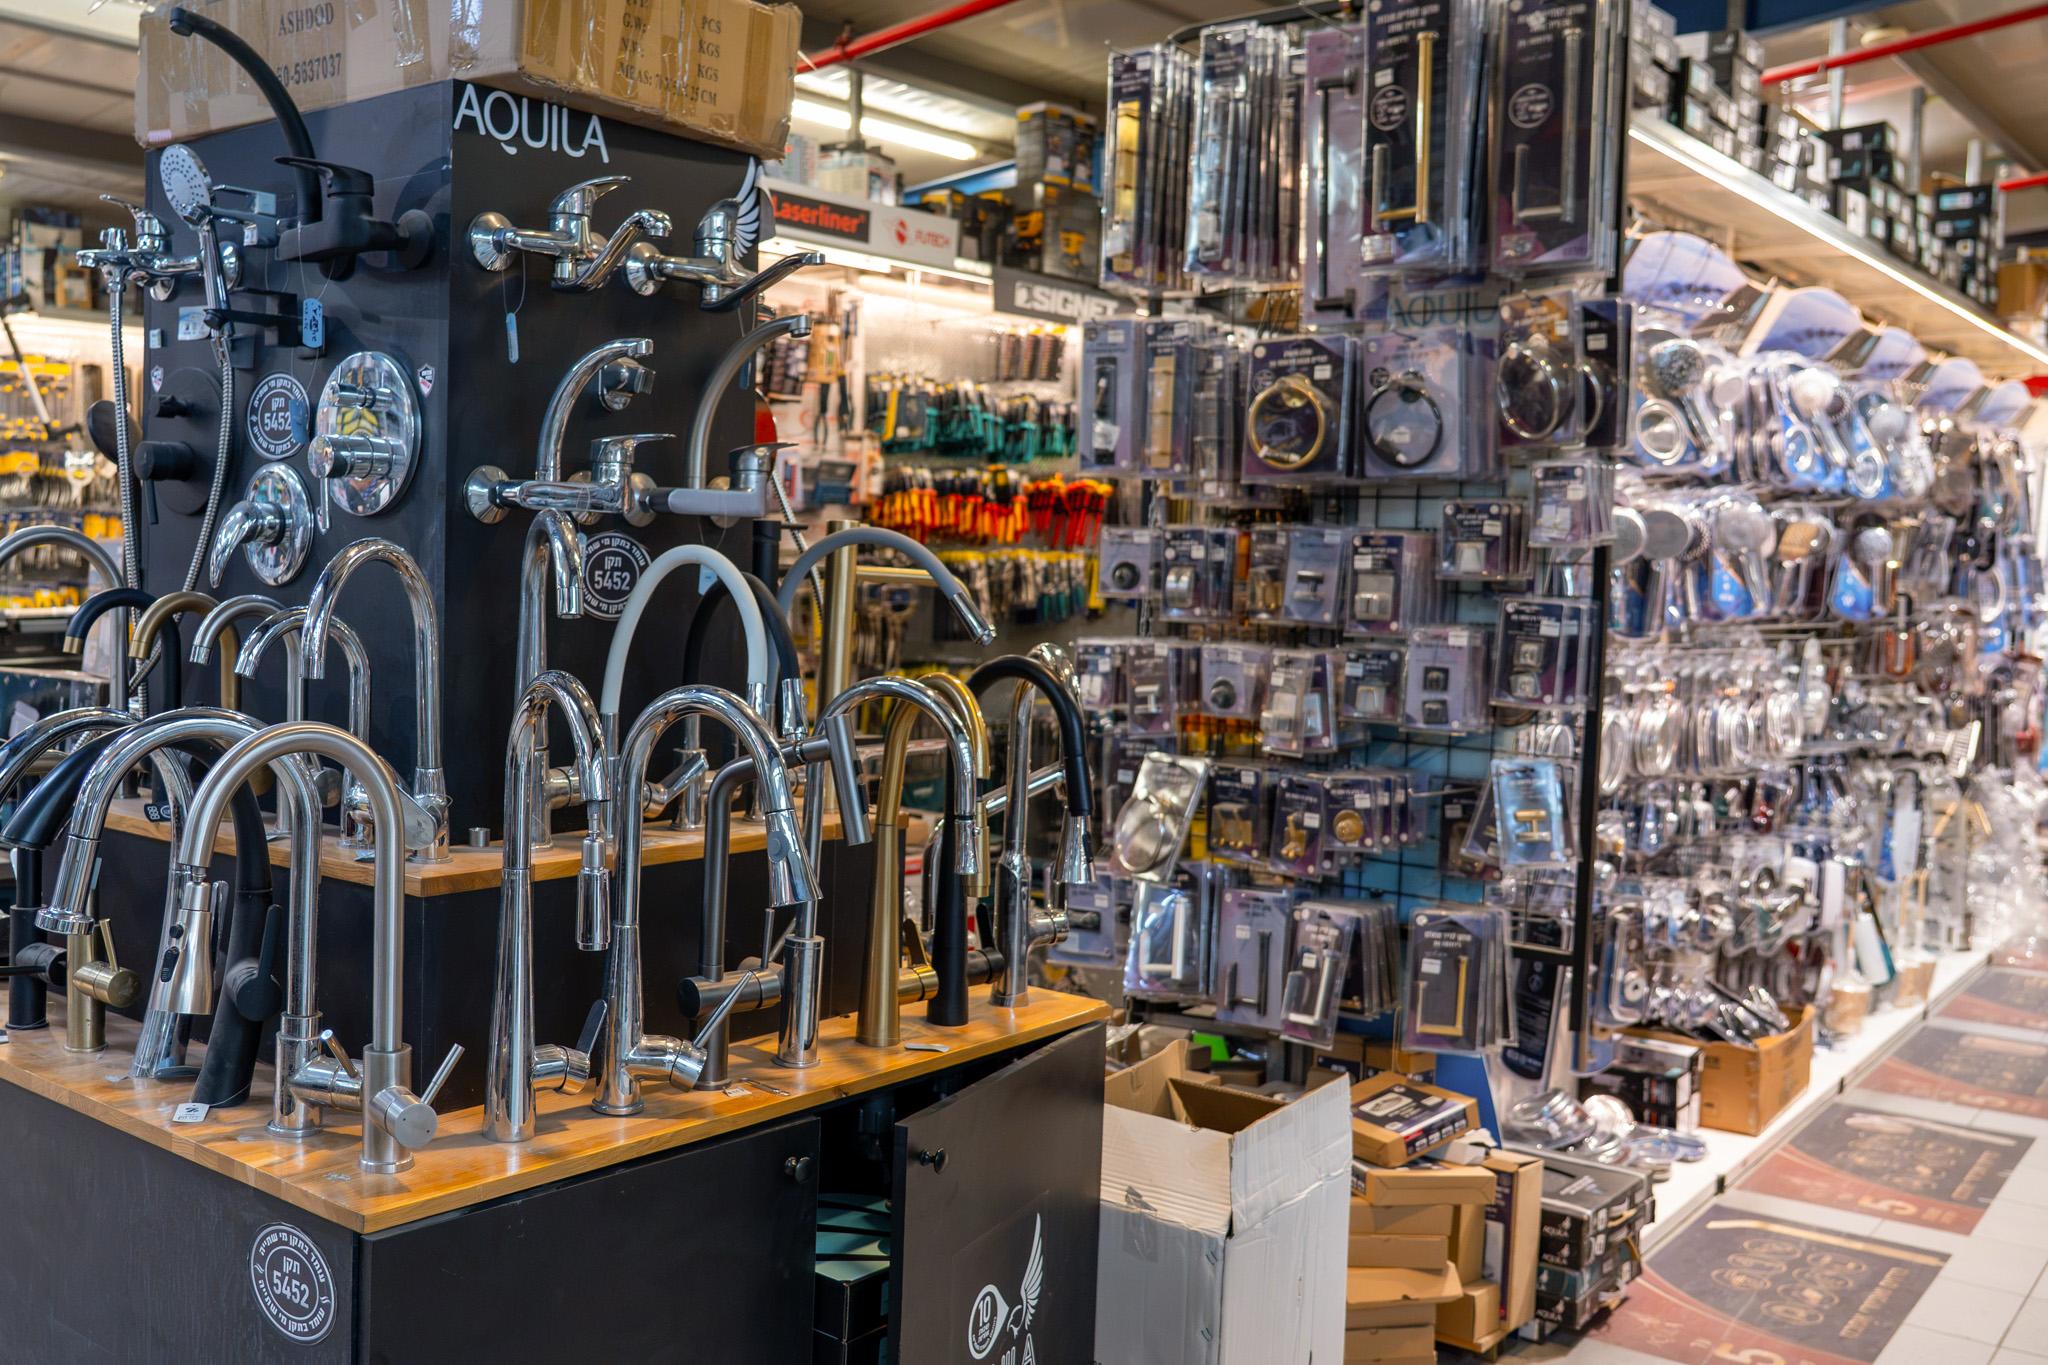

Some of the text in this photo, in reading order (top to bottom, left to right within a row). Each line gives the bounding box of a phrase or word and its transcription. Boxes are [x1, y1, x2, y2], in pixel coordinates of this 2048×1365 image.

[277, 1, 335, 38] ASHDOD
[701, 15, 722, 34] PCS
[698, 39, 720, 58] KGS
[697, 63, 719, 83] KGS
[453, 83, 609, 164] AQUILA
[773, 194, 859, 235] Laserliner
[271, 397, 285, 411] תקן
[264, 411, 292, 431] 5452
[601, 538, 610, 546] מי
[611, 537, 631, 550] בתקן
[604, 556, 622, 570] תקן
[594, 570, 631, 591] 5452
[258, 1232, 326, 1283] עומד בתקן מי שתייה
[283, 1255, 300, 1275] תקן
[273, 1269, 310, 1309] 5452
[258, 1279, 326, 1333] עומד בתקן מי שתייה
[978, 1295, 992, 1327] 10
